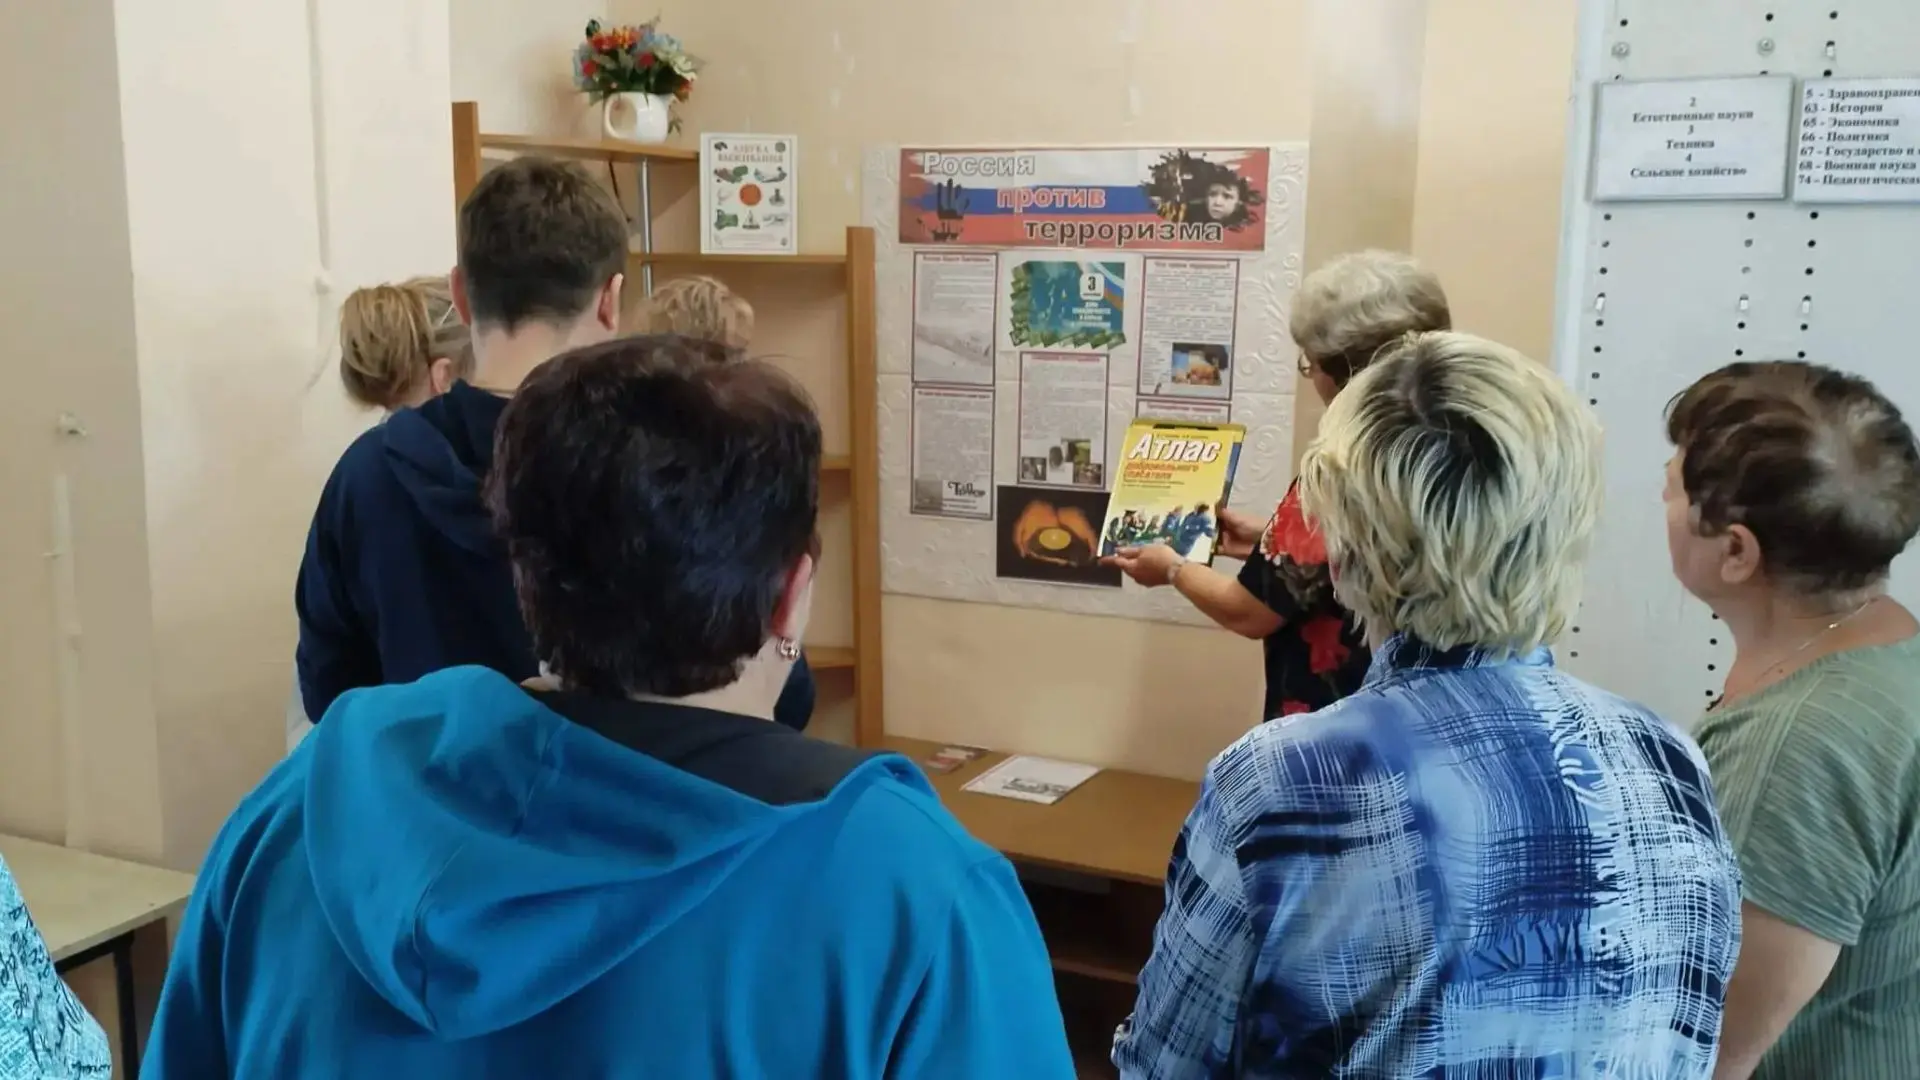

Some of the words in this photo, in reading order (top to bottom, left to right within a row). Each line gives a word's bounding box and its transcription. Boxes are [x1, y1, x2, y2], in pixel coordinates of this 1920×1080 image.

[1806, 88, 1813, 98] 5
[1689, 96, 1697, 107] 2
[1804, 103, 1818, 113] 63
[1829, 102, 1883, 115] История
[1632, 112, 1714, 123] Естественные
[1717, 110, 1754, 121] науки
[1803, 117, 1817, 127] 65
[1828, 117, 1900, 127] Экономика
[1687, 124, 1694, 135] 3
[1801, 132, 1815, 142] 66
[1826, 131, 1890, 142] Политика
[1666, 139, 1715, 150] Техника
[1685, 153, 1692, 163] 4
[1800, 146, 1814, 156] 67
[1825, 146, 1903, 158] Государство
[1906, 147, 1914, 156] и
[923, 151, 1036, 176] Россия
[1799, 160, 1813, 170] 68
[1824, 160, 1876, 170] Военная
[1880, 161, 1916, 173] наука
[1630, 167, 1684, 179] Сельское
[1687, 165, 1747, 177] хозяйство
[1798, 174, 1811, 184] 74
[996, 187, 1106, 213] против
[1024, 220, 1223, 247] терроризма
[1087, 275, 1097, 292] 3
[1128, 432, 1223, 464] Атлас
